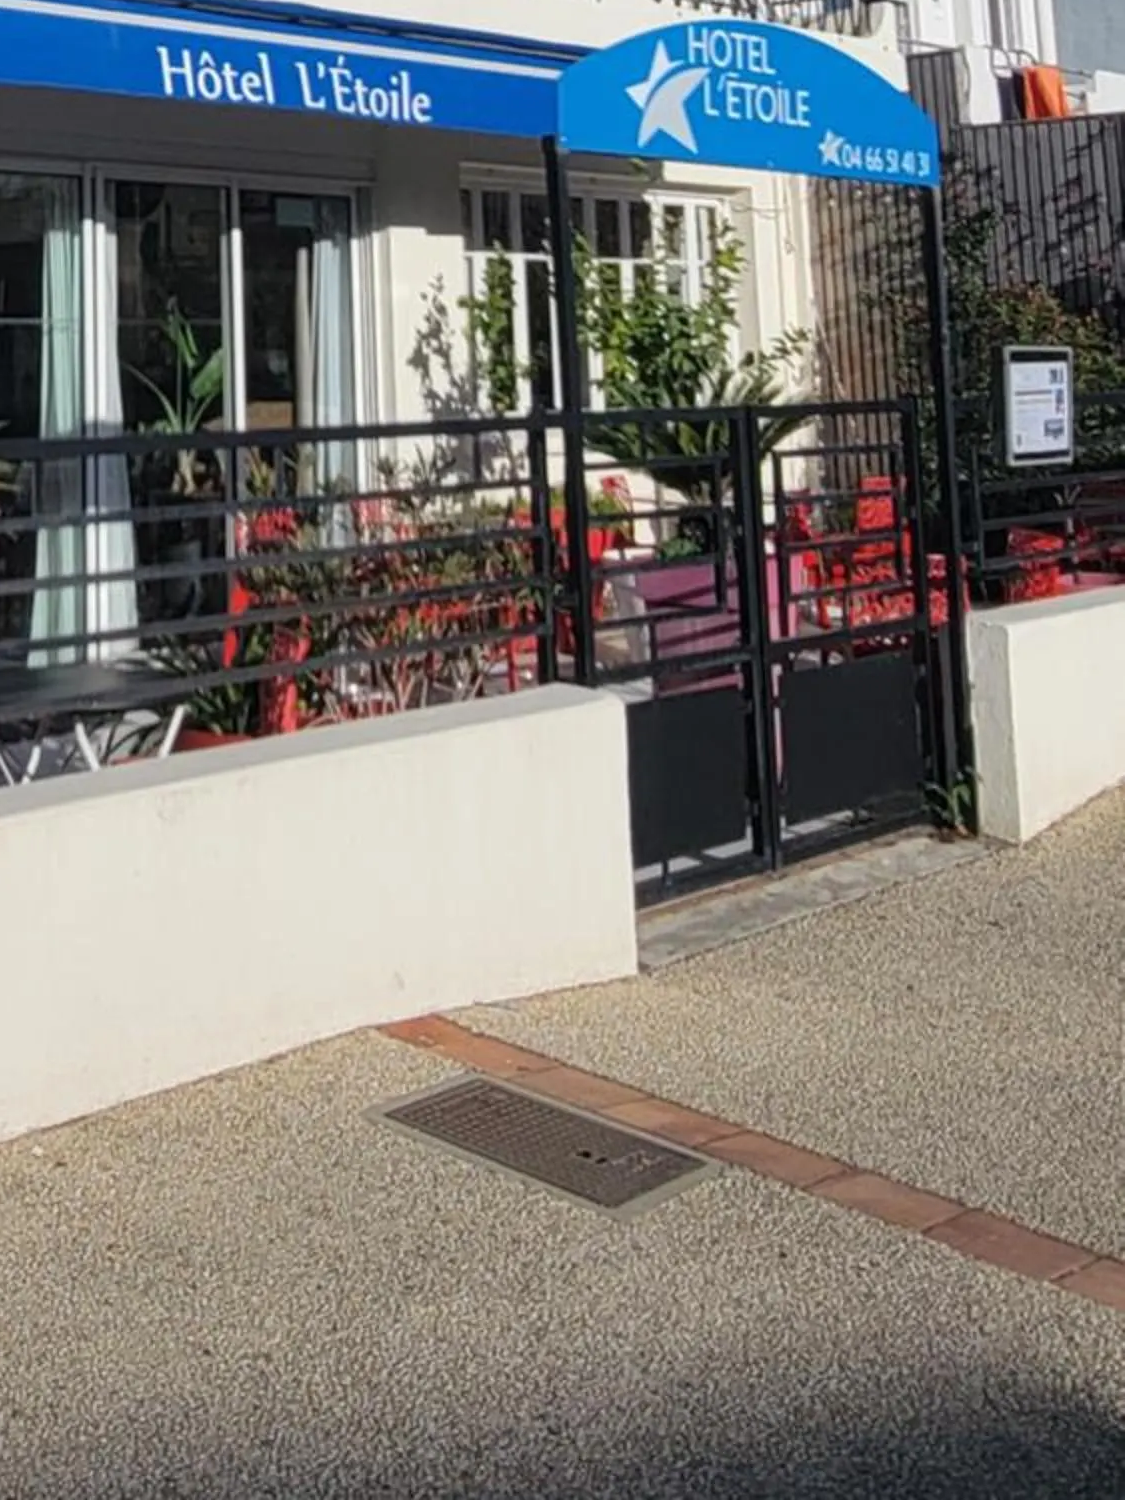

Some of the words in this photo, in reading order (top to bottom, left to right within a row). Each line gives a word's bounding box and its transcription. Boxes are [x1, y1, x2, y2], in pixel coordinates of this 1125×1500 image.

[687, 25, 777, 75] HOTEL
[156, 45, 275, 105] Hôtel
[295, 54, 433, 123] L'Étoile
